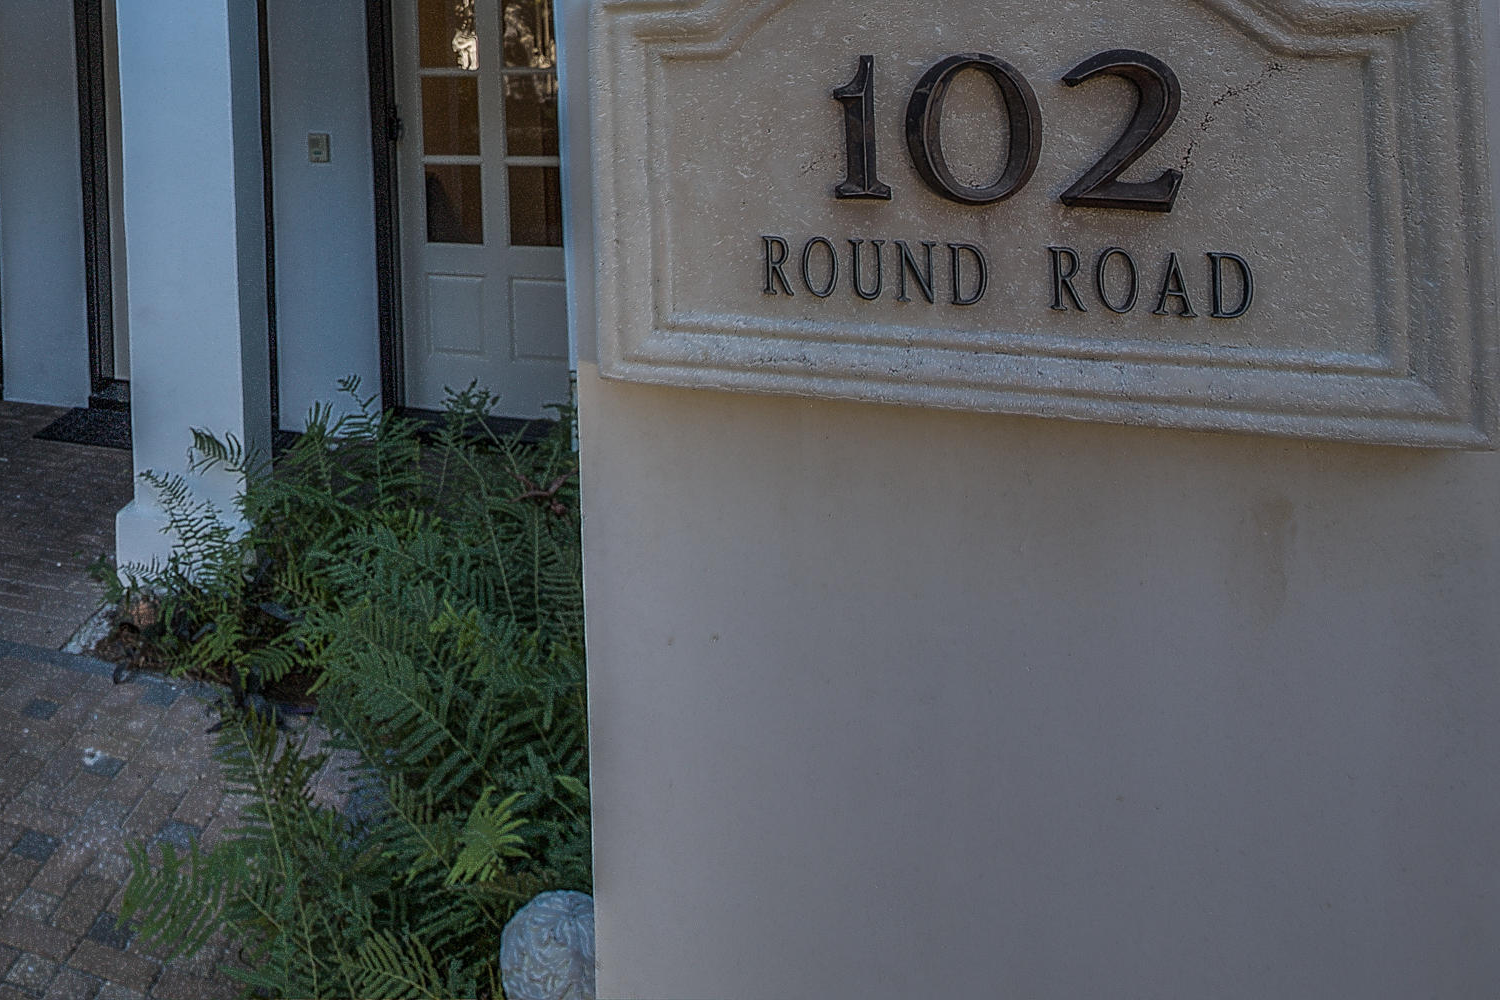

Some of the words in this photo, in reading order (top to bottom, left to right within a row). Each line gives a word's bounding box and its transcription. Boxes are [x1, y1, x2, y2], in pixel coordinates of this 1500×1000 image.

[833, 48, 1183, 213] 102
[761, 235, 988, 306] ROUND
[1047, 246, 1255, 319] ROAD
